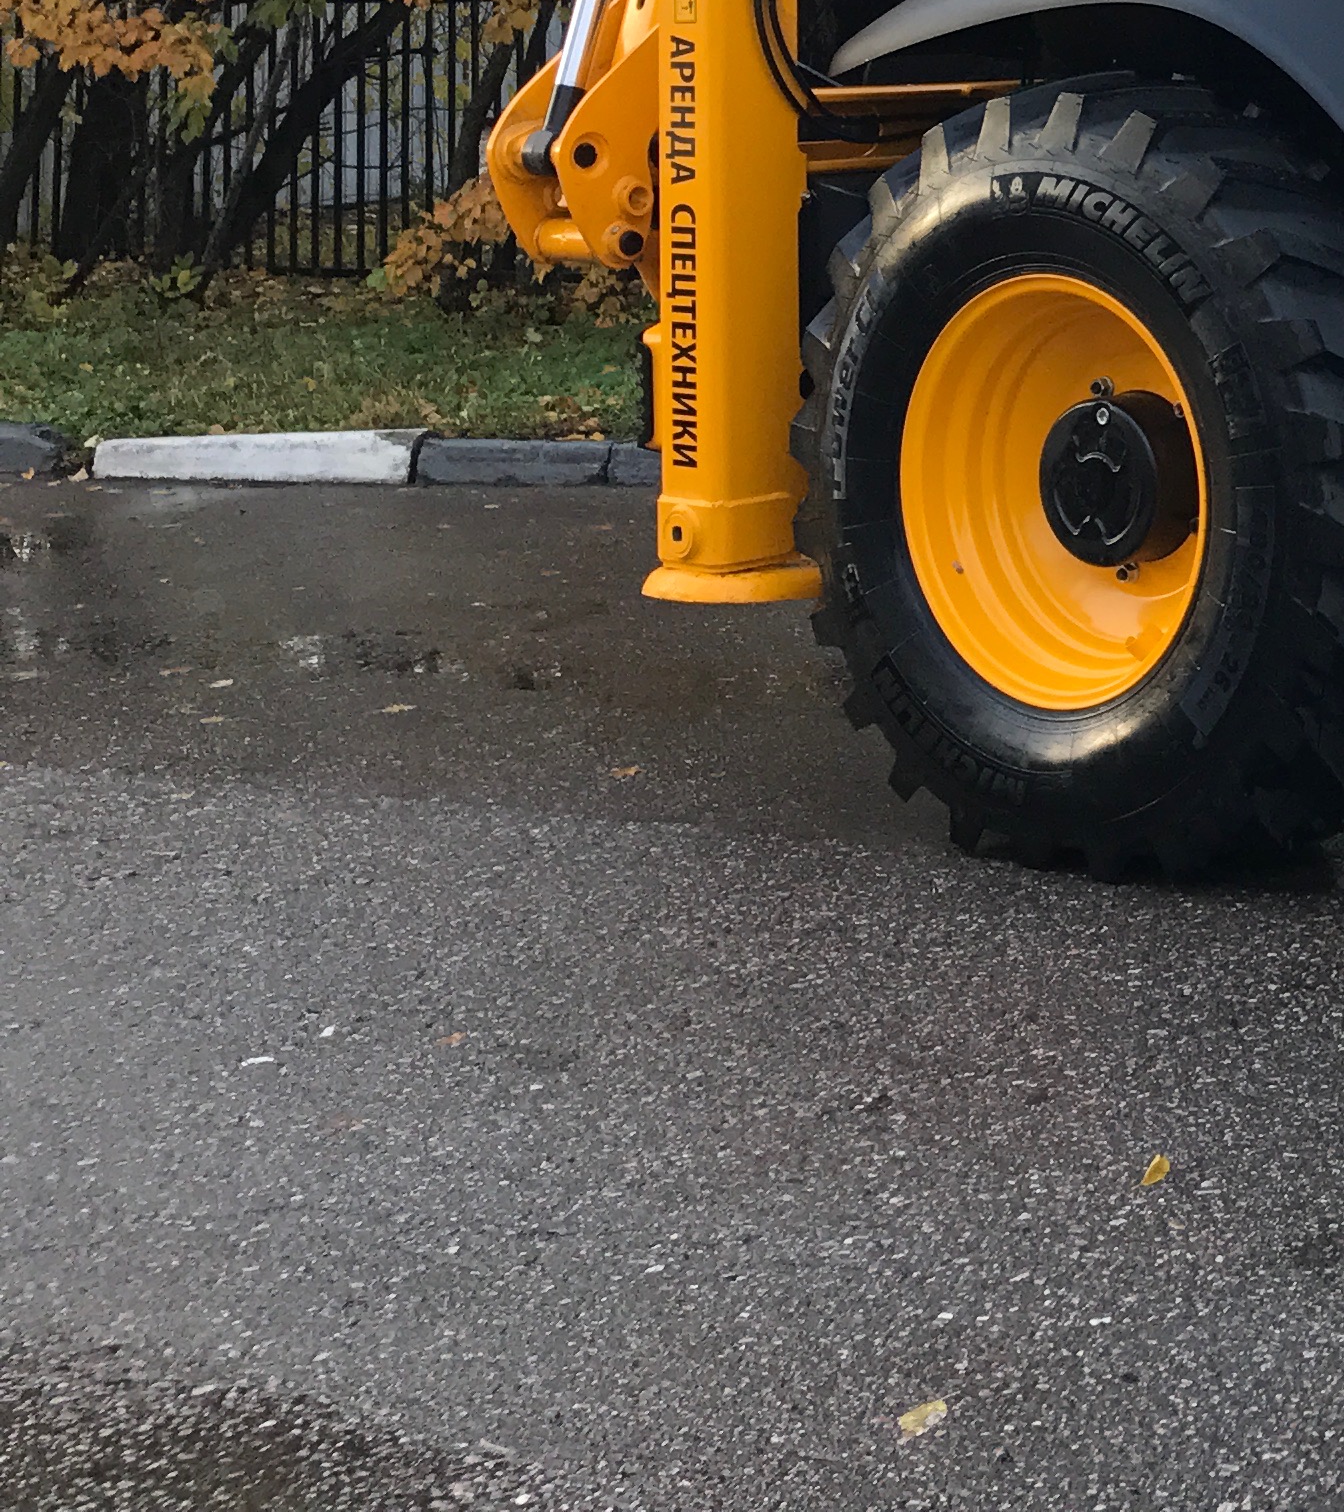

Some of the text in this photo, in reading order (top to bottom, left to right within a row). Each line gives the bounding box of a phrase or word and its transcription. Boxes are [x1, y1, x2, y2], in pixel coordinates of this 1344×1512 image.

[665, 35, 698, 469] АРЕНДА СПЕЦТЕХНИКИ
[1033, 176, 1213, 305] MICHELIN
